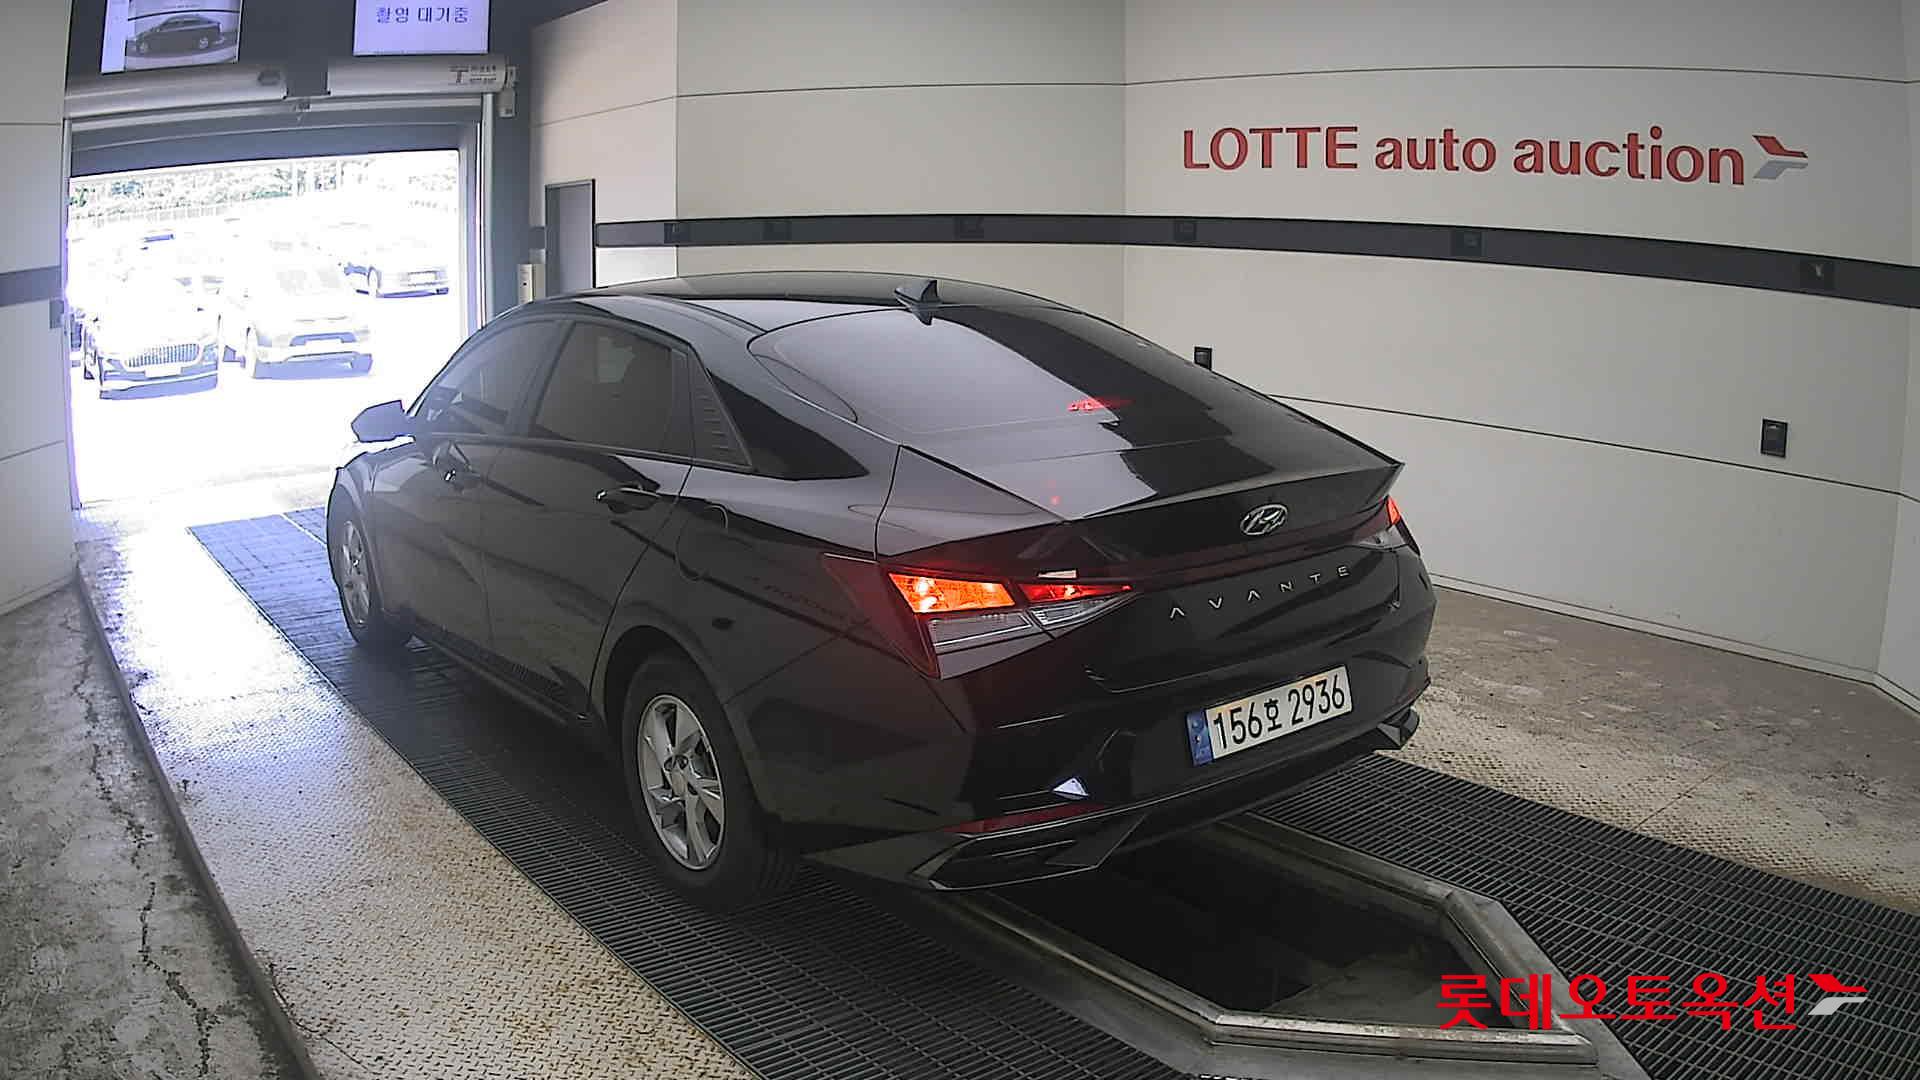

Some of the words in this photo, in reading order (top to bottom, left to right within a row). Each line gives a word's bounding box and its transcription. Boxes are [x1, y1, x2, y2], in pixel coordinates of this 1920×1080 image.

[417, 7, 469, 23] 대기중
[1183, 126, 1358, 170] LOTTE
[1375, 128, 1497, 172] auto
[1513, 126, 1745, 185] auction
[1169, 565, 1351, 619] AVANTE
[1213, 698, 1282, 749] 156호
[1287, 673, 1346, 726] 2936
